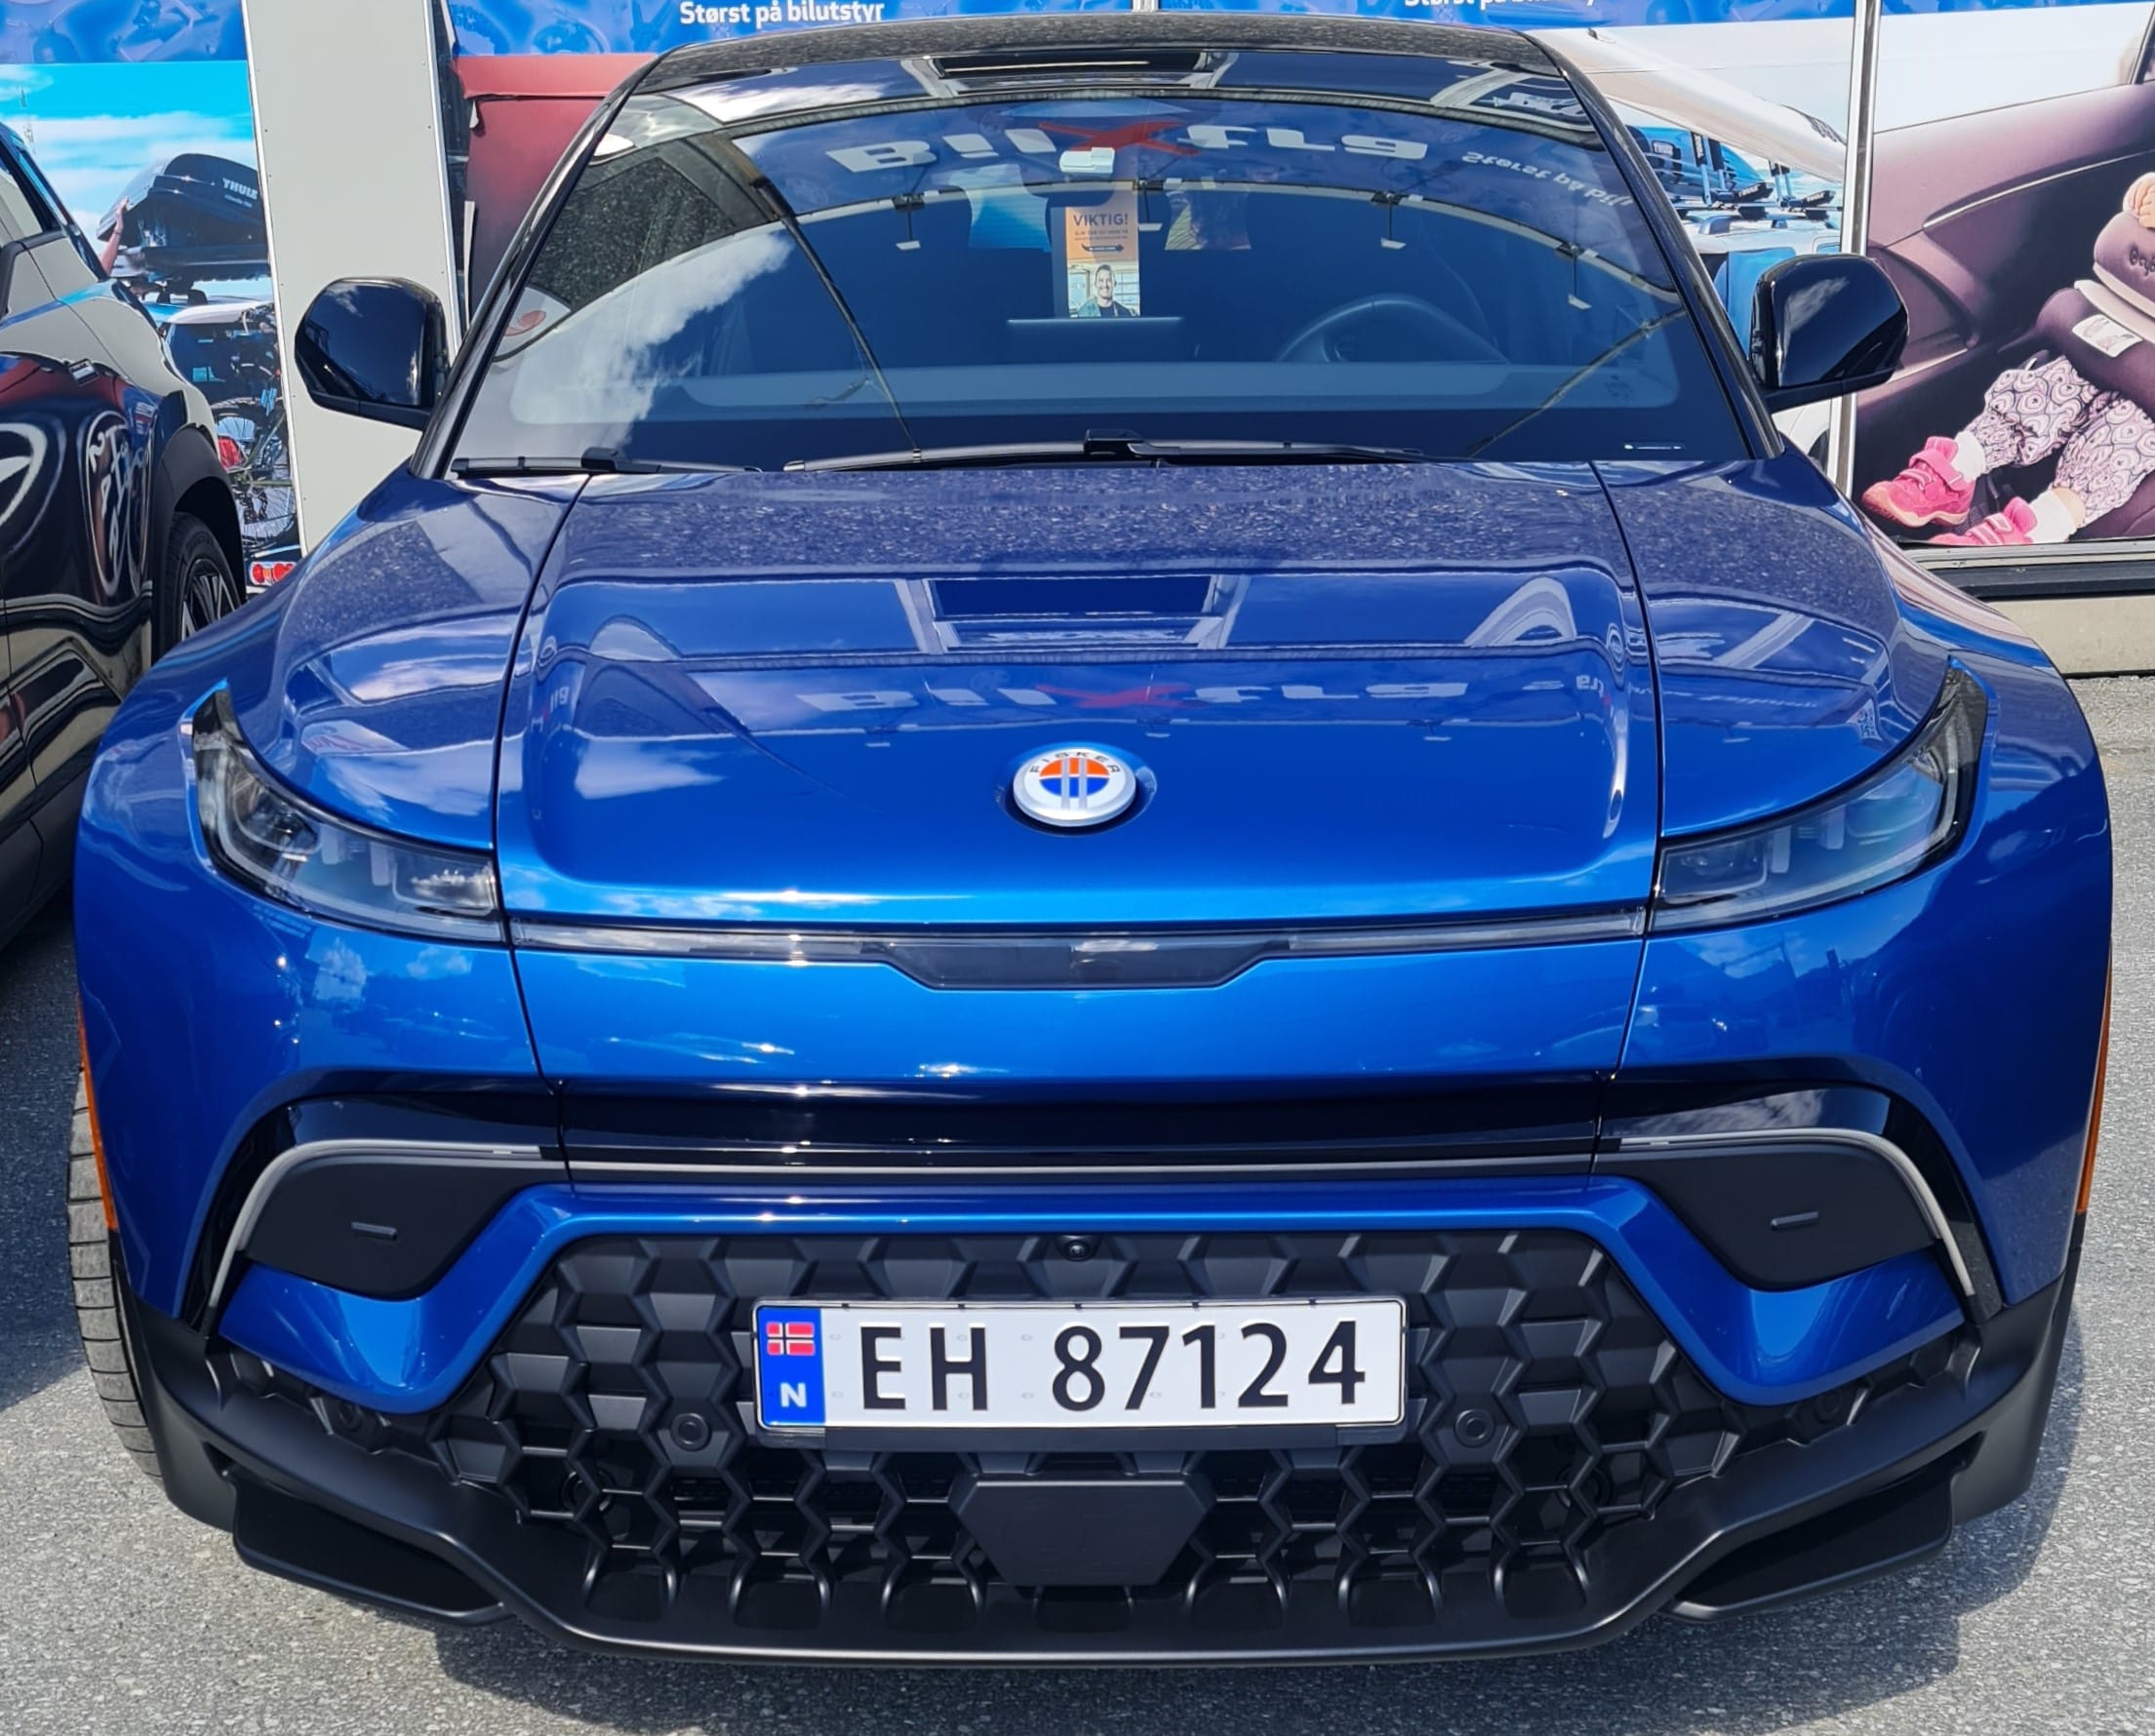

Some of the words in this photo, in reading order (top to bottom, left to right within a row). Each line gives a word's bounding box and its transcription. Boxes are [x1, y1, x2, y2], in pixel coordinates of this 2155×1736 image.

[679, 2, 751, 24] Størst
[755, 5, 782, 29] på
[787, 0, 885, 23] bilutstyr
[221, 178, 259, 200] THULE
[1073, 213, 1129, 226] VIKTIG!
[1029, 751, 1120, 773] FISKER
[858, 1324, 988, 1411] EH
[1052, 1320, 1367, 1411] 87124
[779, 1382, 807, 1408] N
